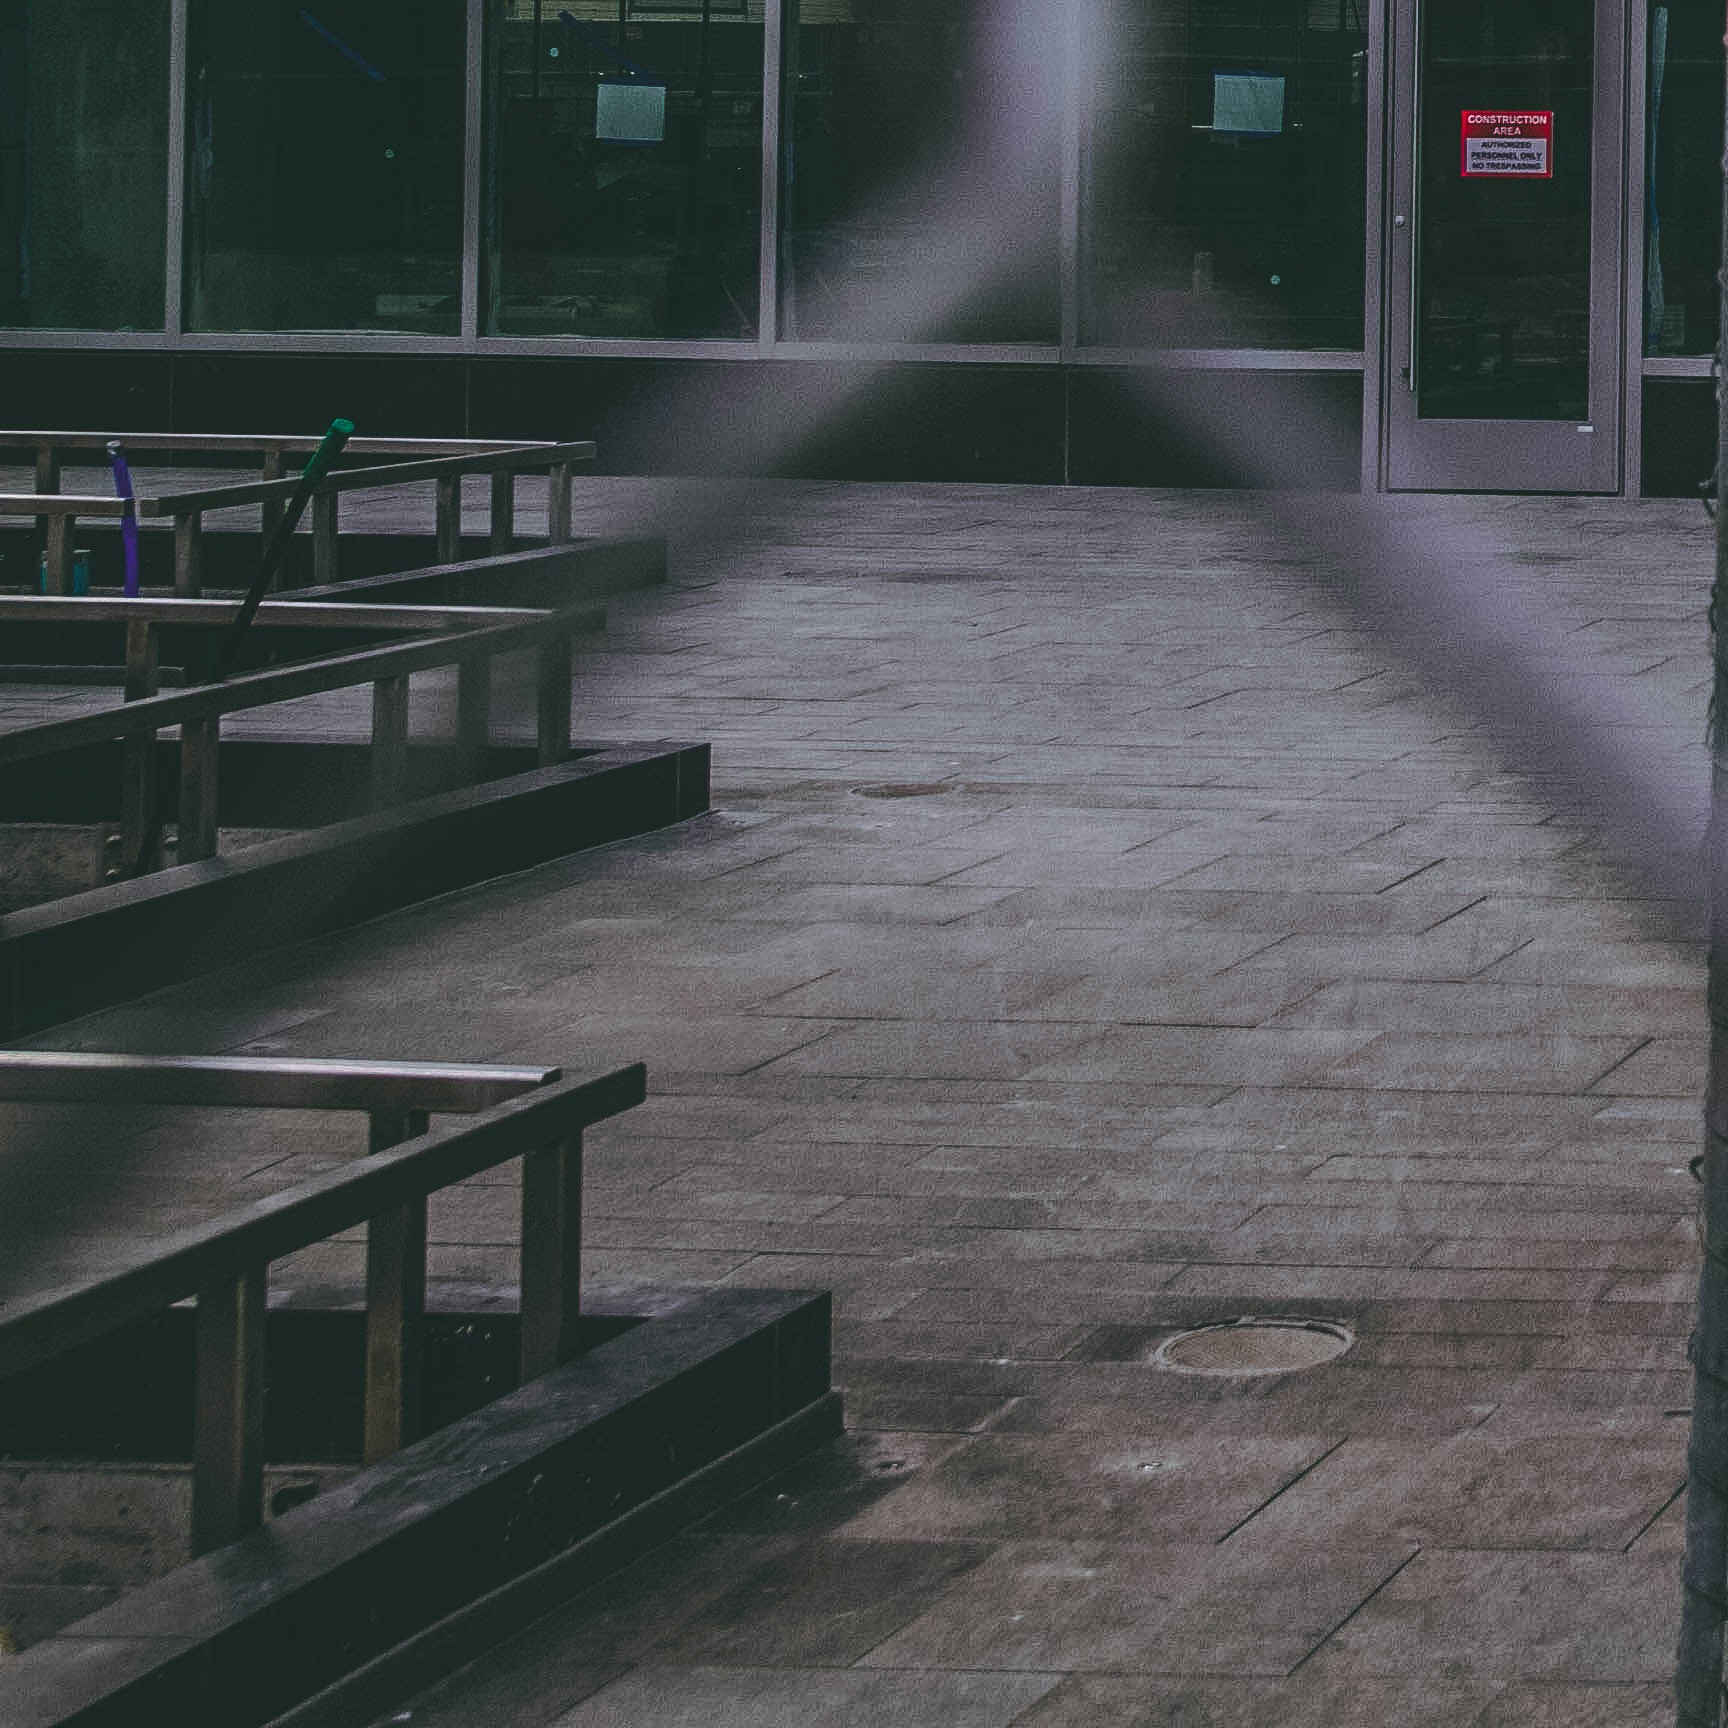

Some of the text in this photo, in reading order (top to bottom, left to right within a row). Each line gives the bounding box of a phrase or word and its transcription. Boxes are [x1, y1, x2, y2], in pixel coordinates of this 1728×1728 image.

[1467, 114, 1547, 125] CONSTRUCTION
[1493, 126, 1521, 136] AREA
[1481, 141, 1532, 149] AUTHORIZED
[1471, 152, 1543, 161] PERSONNEL ONLY
[1472, 162, 1485, 170] NO
